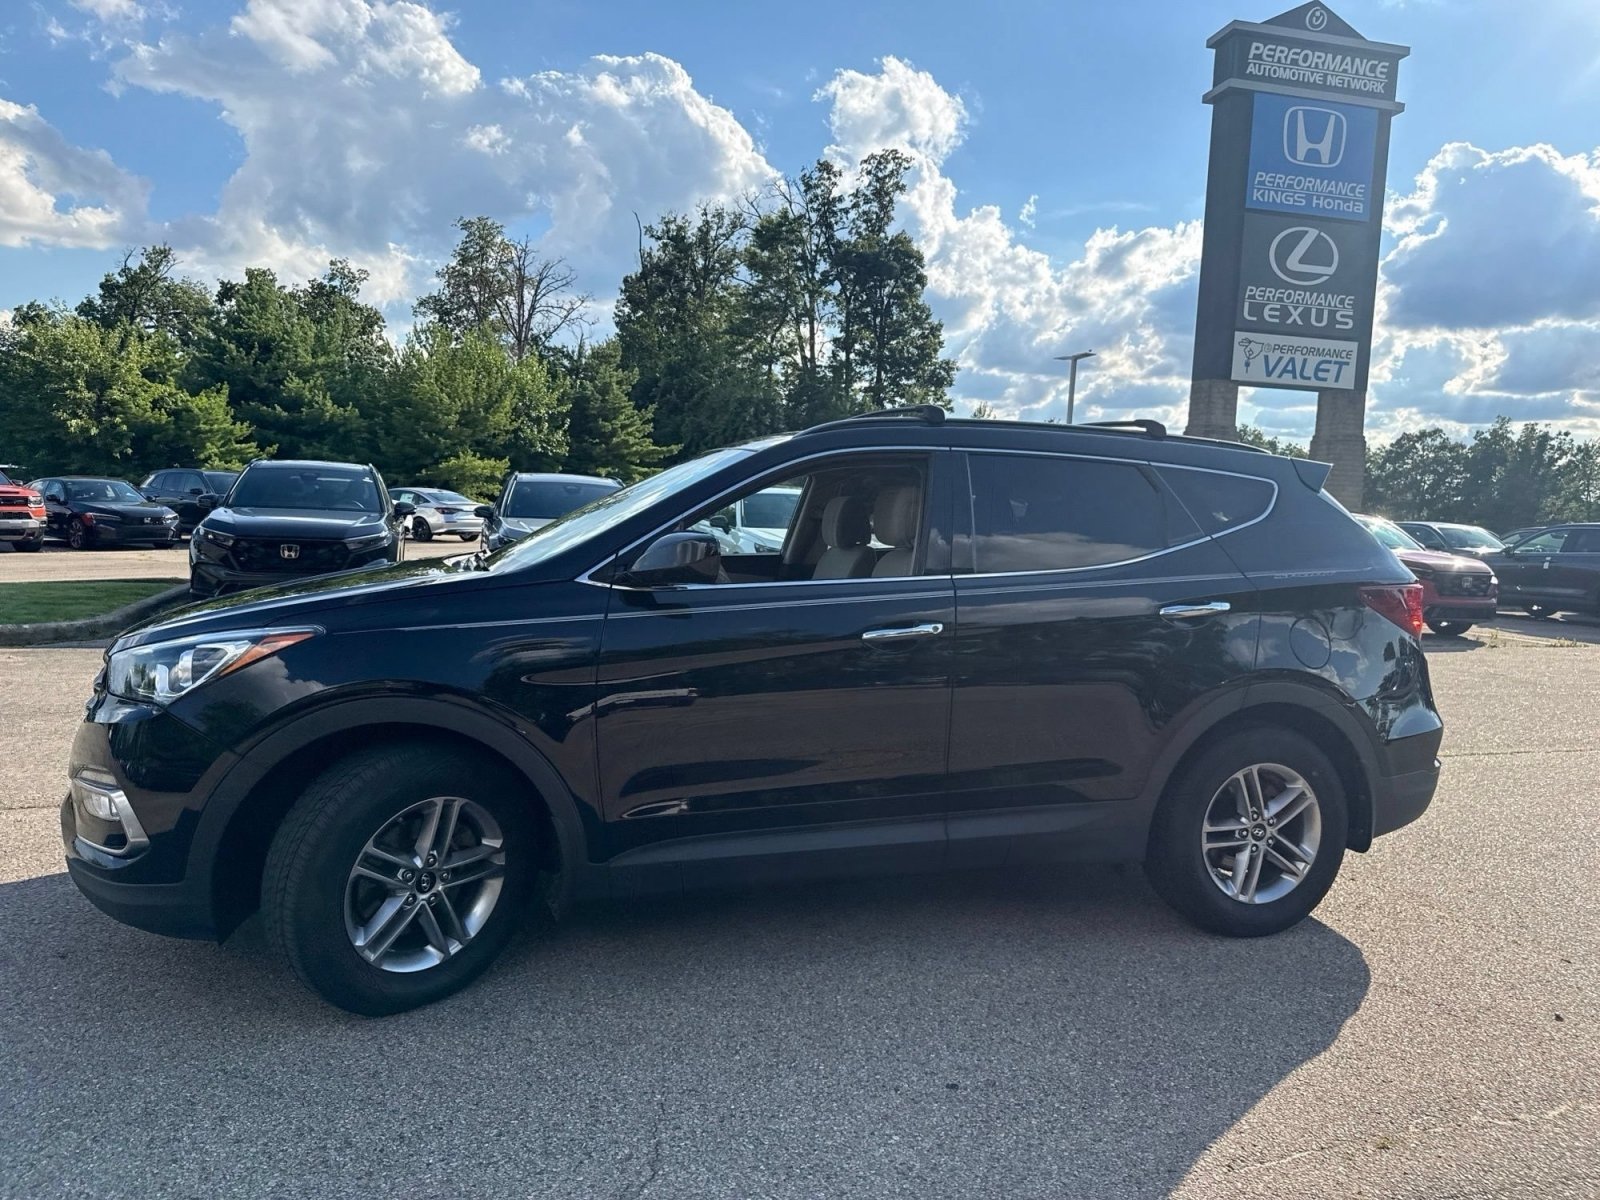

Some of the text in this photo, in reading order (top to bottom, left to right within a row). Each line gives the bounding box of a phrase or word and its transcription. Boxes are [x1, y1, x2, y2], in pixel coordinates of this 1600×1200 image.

[1248, 42, 1389, 79] PERFORMANCE
[1246, 63, 1385, 94] AUTOMOTIVE NETWORK
[1254, 172, 1366, 197] PERFORMANCE
[1253, 188, 1364, 214] KINGS Honda
[1245, 286, 1355, 309] PERFORMANCE
[1243, 301, 1354, 330] LEXUS
[1272, 343, 1353, 360] PERFORMANCE
[1263, 354, 1350, 383] VALET
